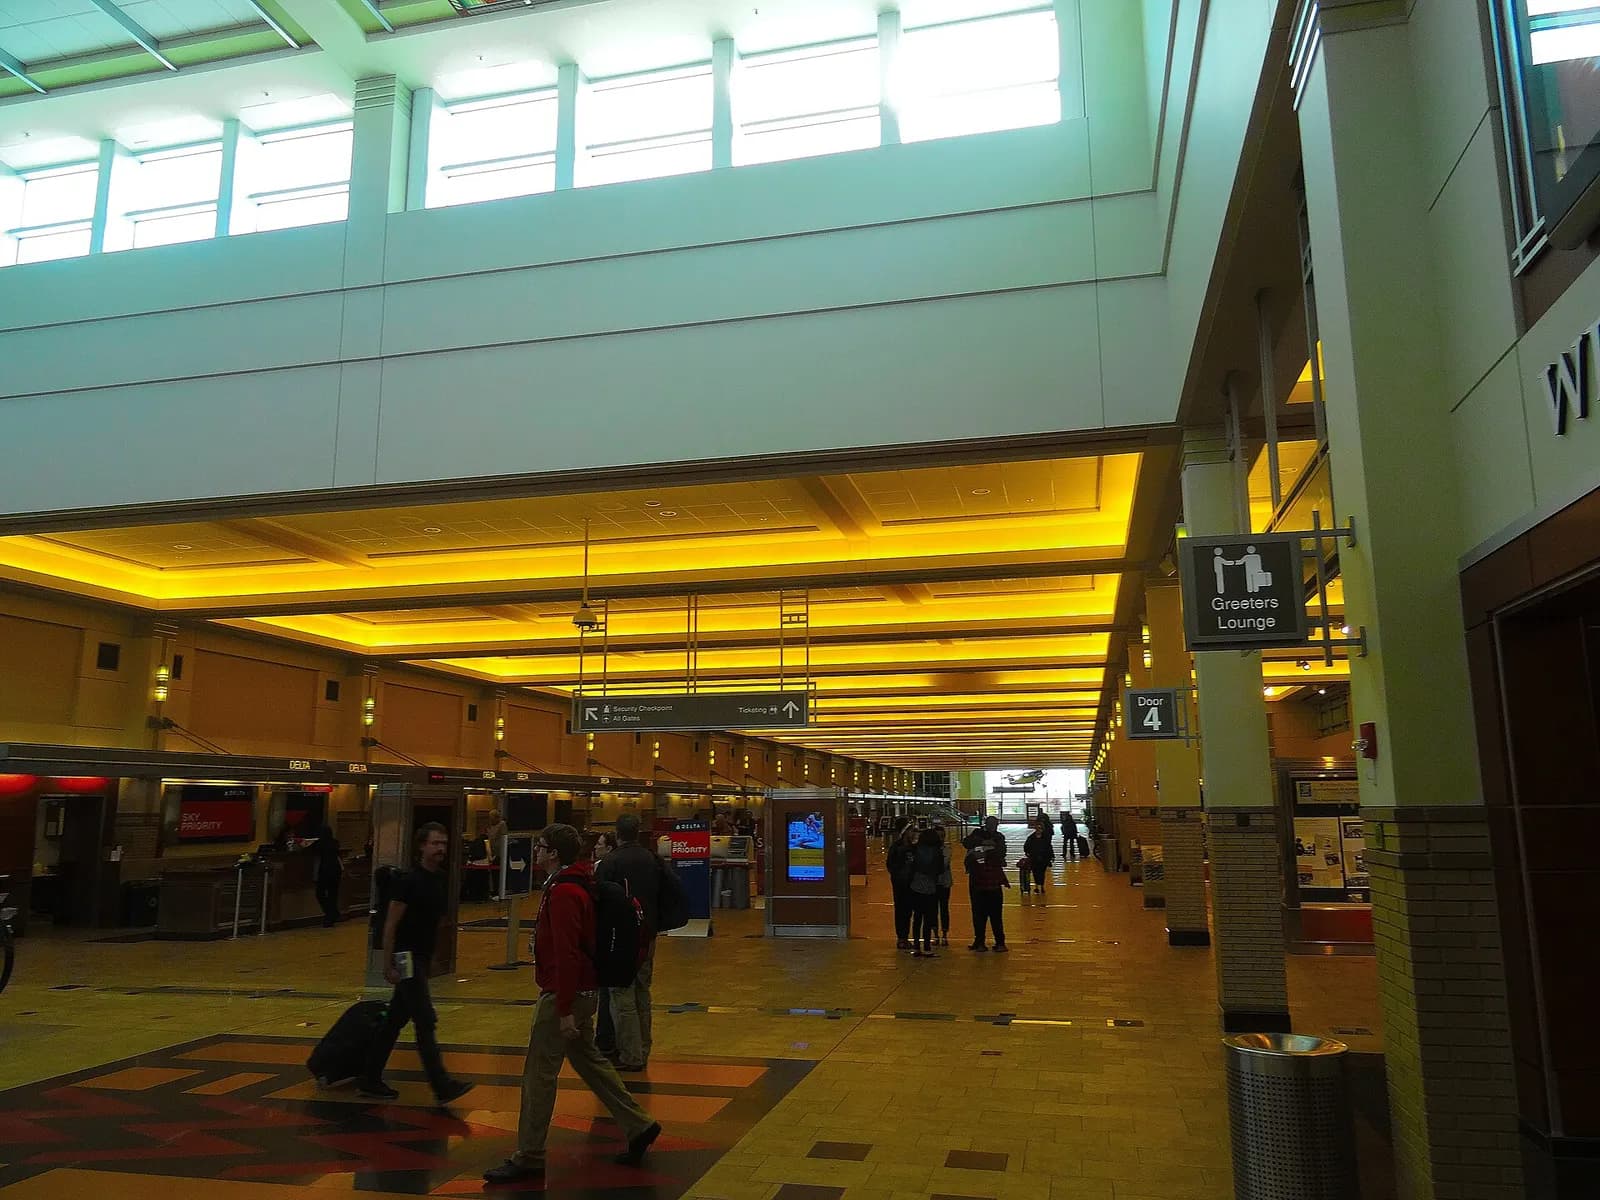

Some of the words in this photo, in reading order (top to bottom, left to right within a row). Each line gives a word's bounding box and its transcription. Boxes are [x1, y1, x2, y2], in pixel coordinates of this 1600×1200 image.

[1538, 322, 1600, 436] W
[1211, 597, 1279, 611] Greeters
[1217, 614, 1276, 631] Lounge
[1137, 696, 1163, 706] Door
[613, 704, 638, 713] Security
[639, 704, 673, 713] Checkpoint
[739, 706, 768, 715] Ticketing
[1143, 707, 1162, 731] 4
[289, 760, 311, 771] DELTA
[348, 763, 368, 773] DELTA
[182, 812, 201, 822] SKY
[180, 820, 223, 832] PRIORITY
[672, 846, 708, 854] PRIORITY
